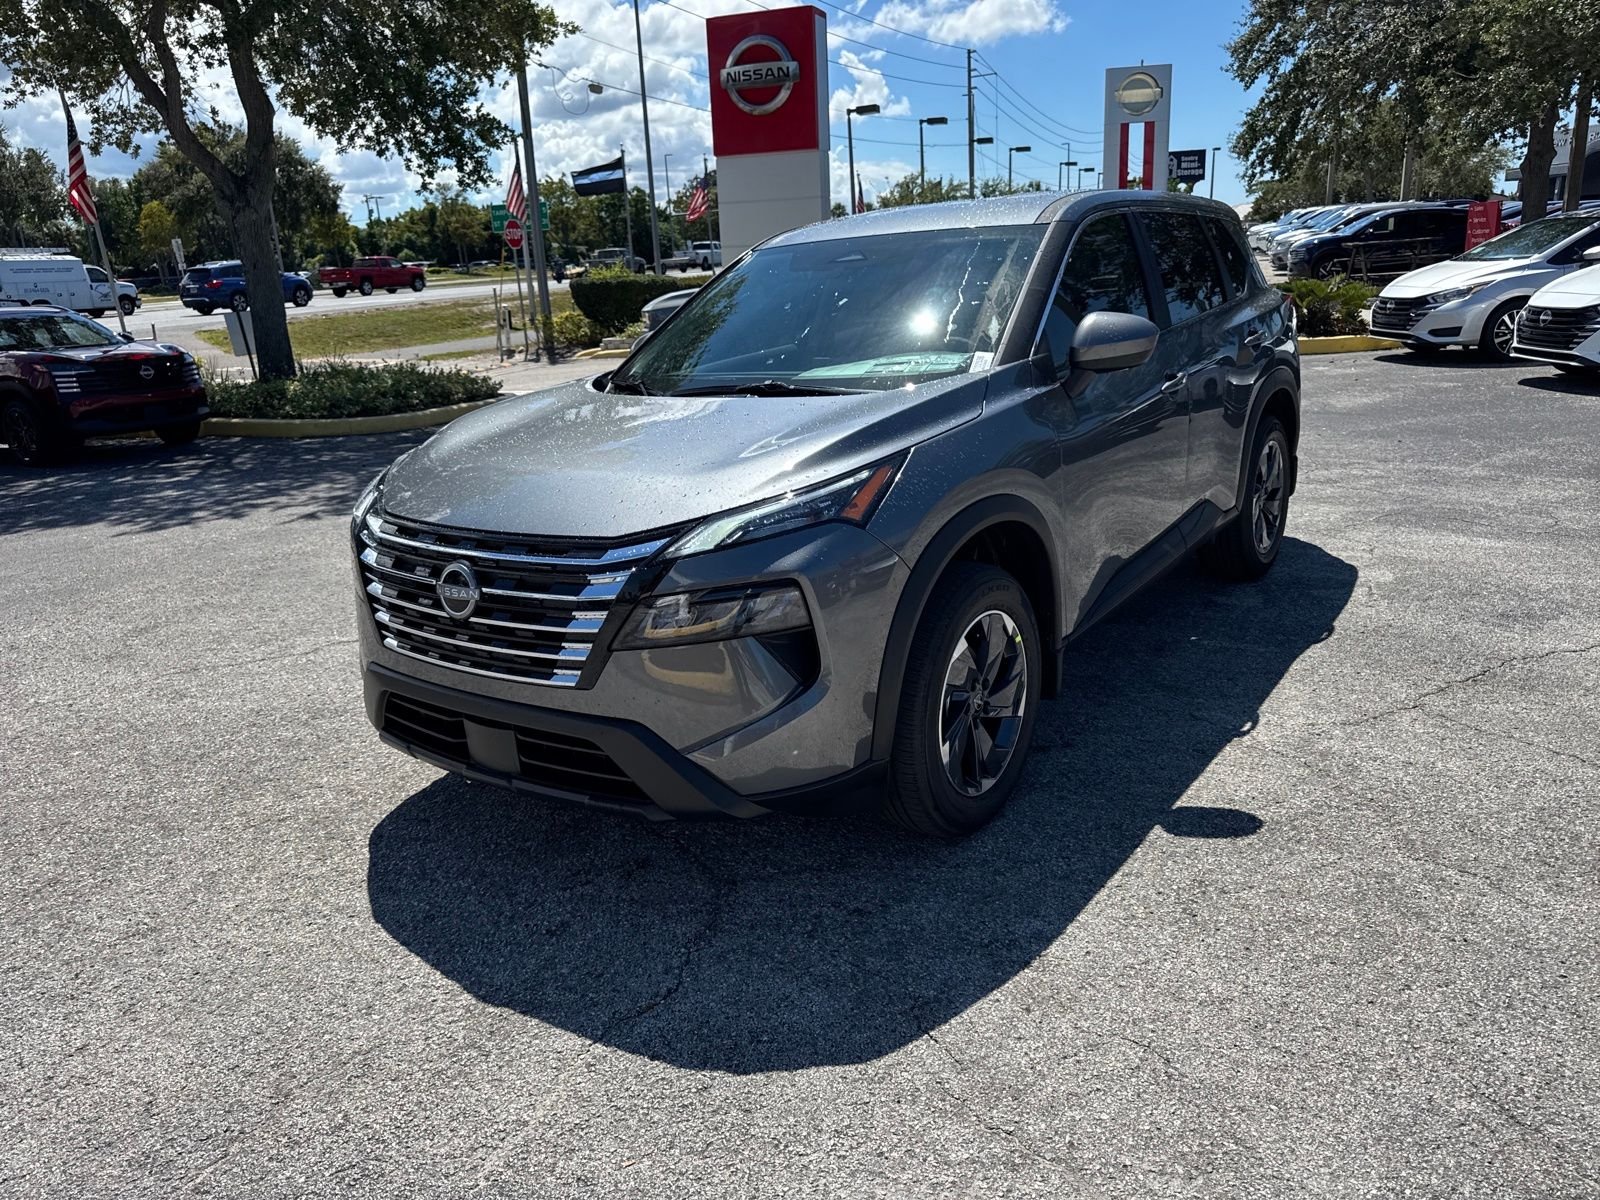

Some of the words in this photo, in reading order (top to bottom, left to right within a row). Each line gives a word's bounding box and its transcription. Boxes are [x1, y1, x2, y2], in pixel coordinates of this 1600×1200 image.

[726, 66, 790, 84] NISSAN
[1181, 161, 1201, 169] Mini-
[1177, 168, 1203, 176] Storage
[506, 228, 521, 240] STOP
